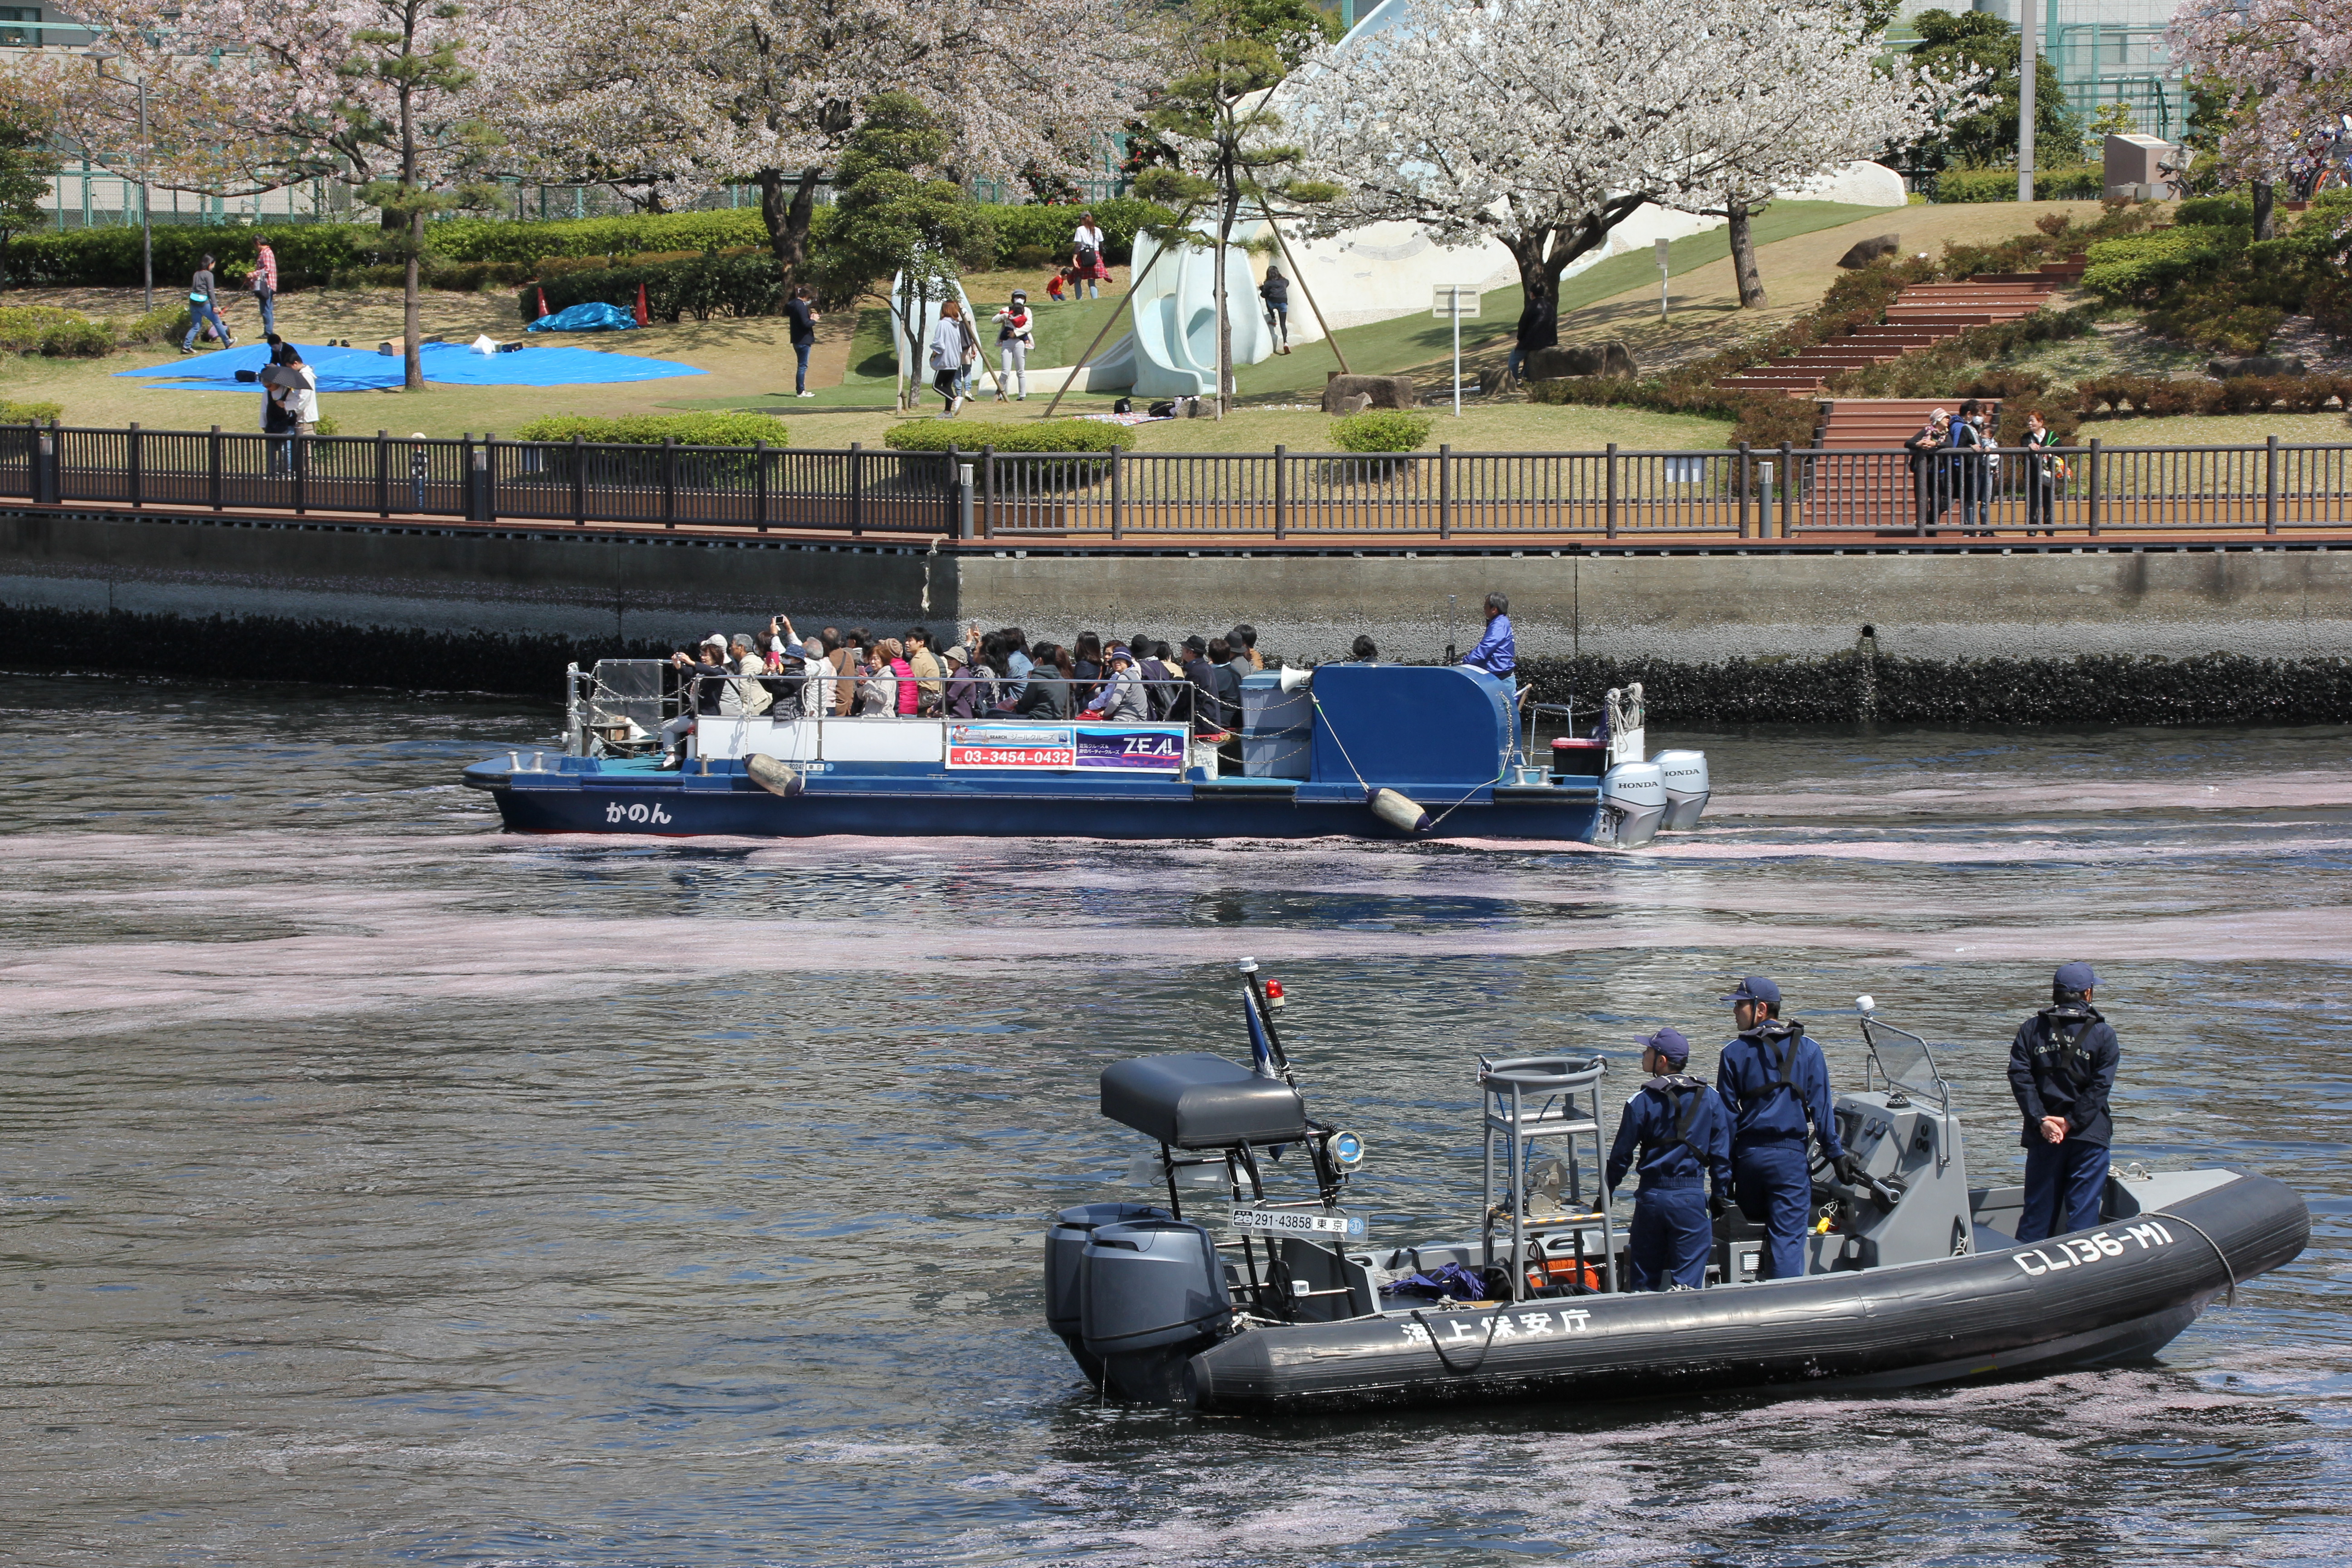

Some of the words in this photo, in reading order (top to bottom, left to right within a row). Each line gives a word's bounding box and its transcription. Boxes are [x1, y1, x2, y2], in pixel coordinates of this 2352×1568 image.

[1123, 737, 1181, 756] ZEAL
[964, 750, 1070, 763] 03-3454-0432
[606, 802, 672, 824] かのん
[1234, 1215, 1252, 1224] 28
[1317, 1218, 1343, 1230] 東京
[1351, 1221, 1359, 1230] 31
[1400, 1308, 1592, 1346] 海上保安庁
